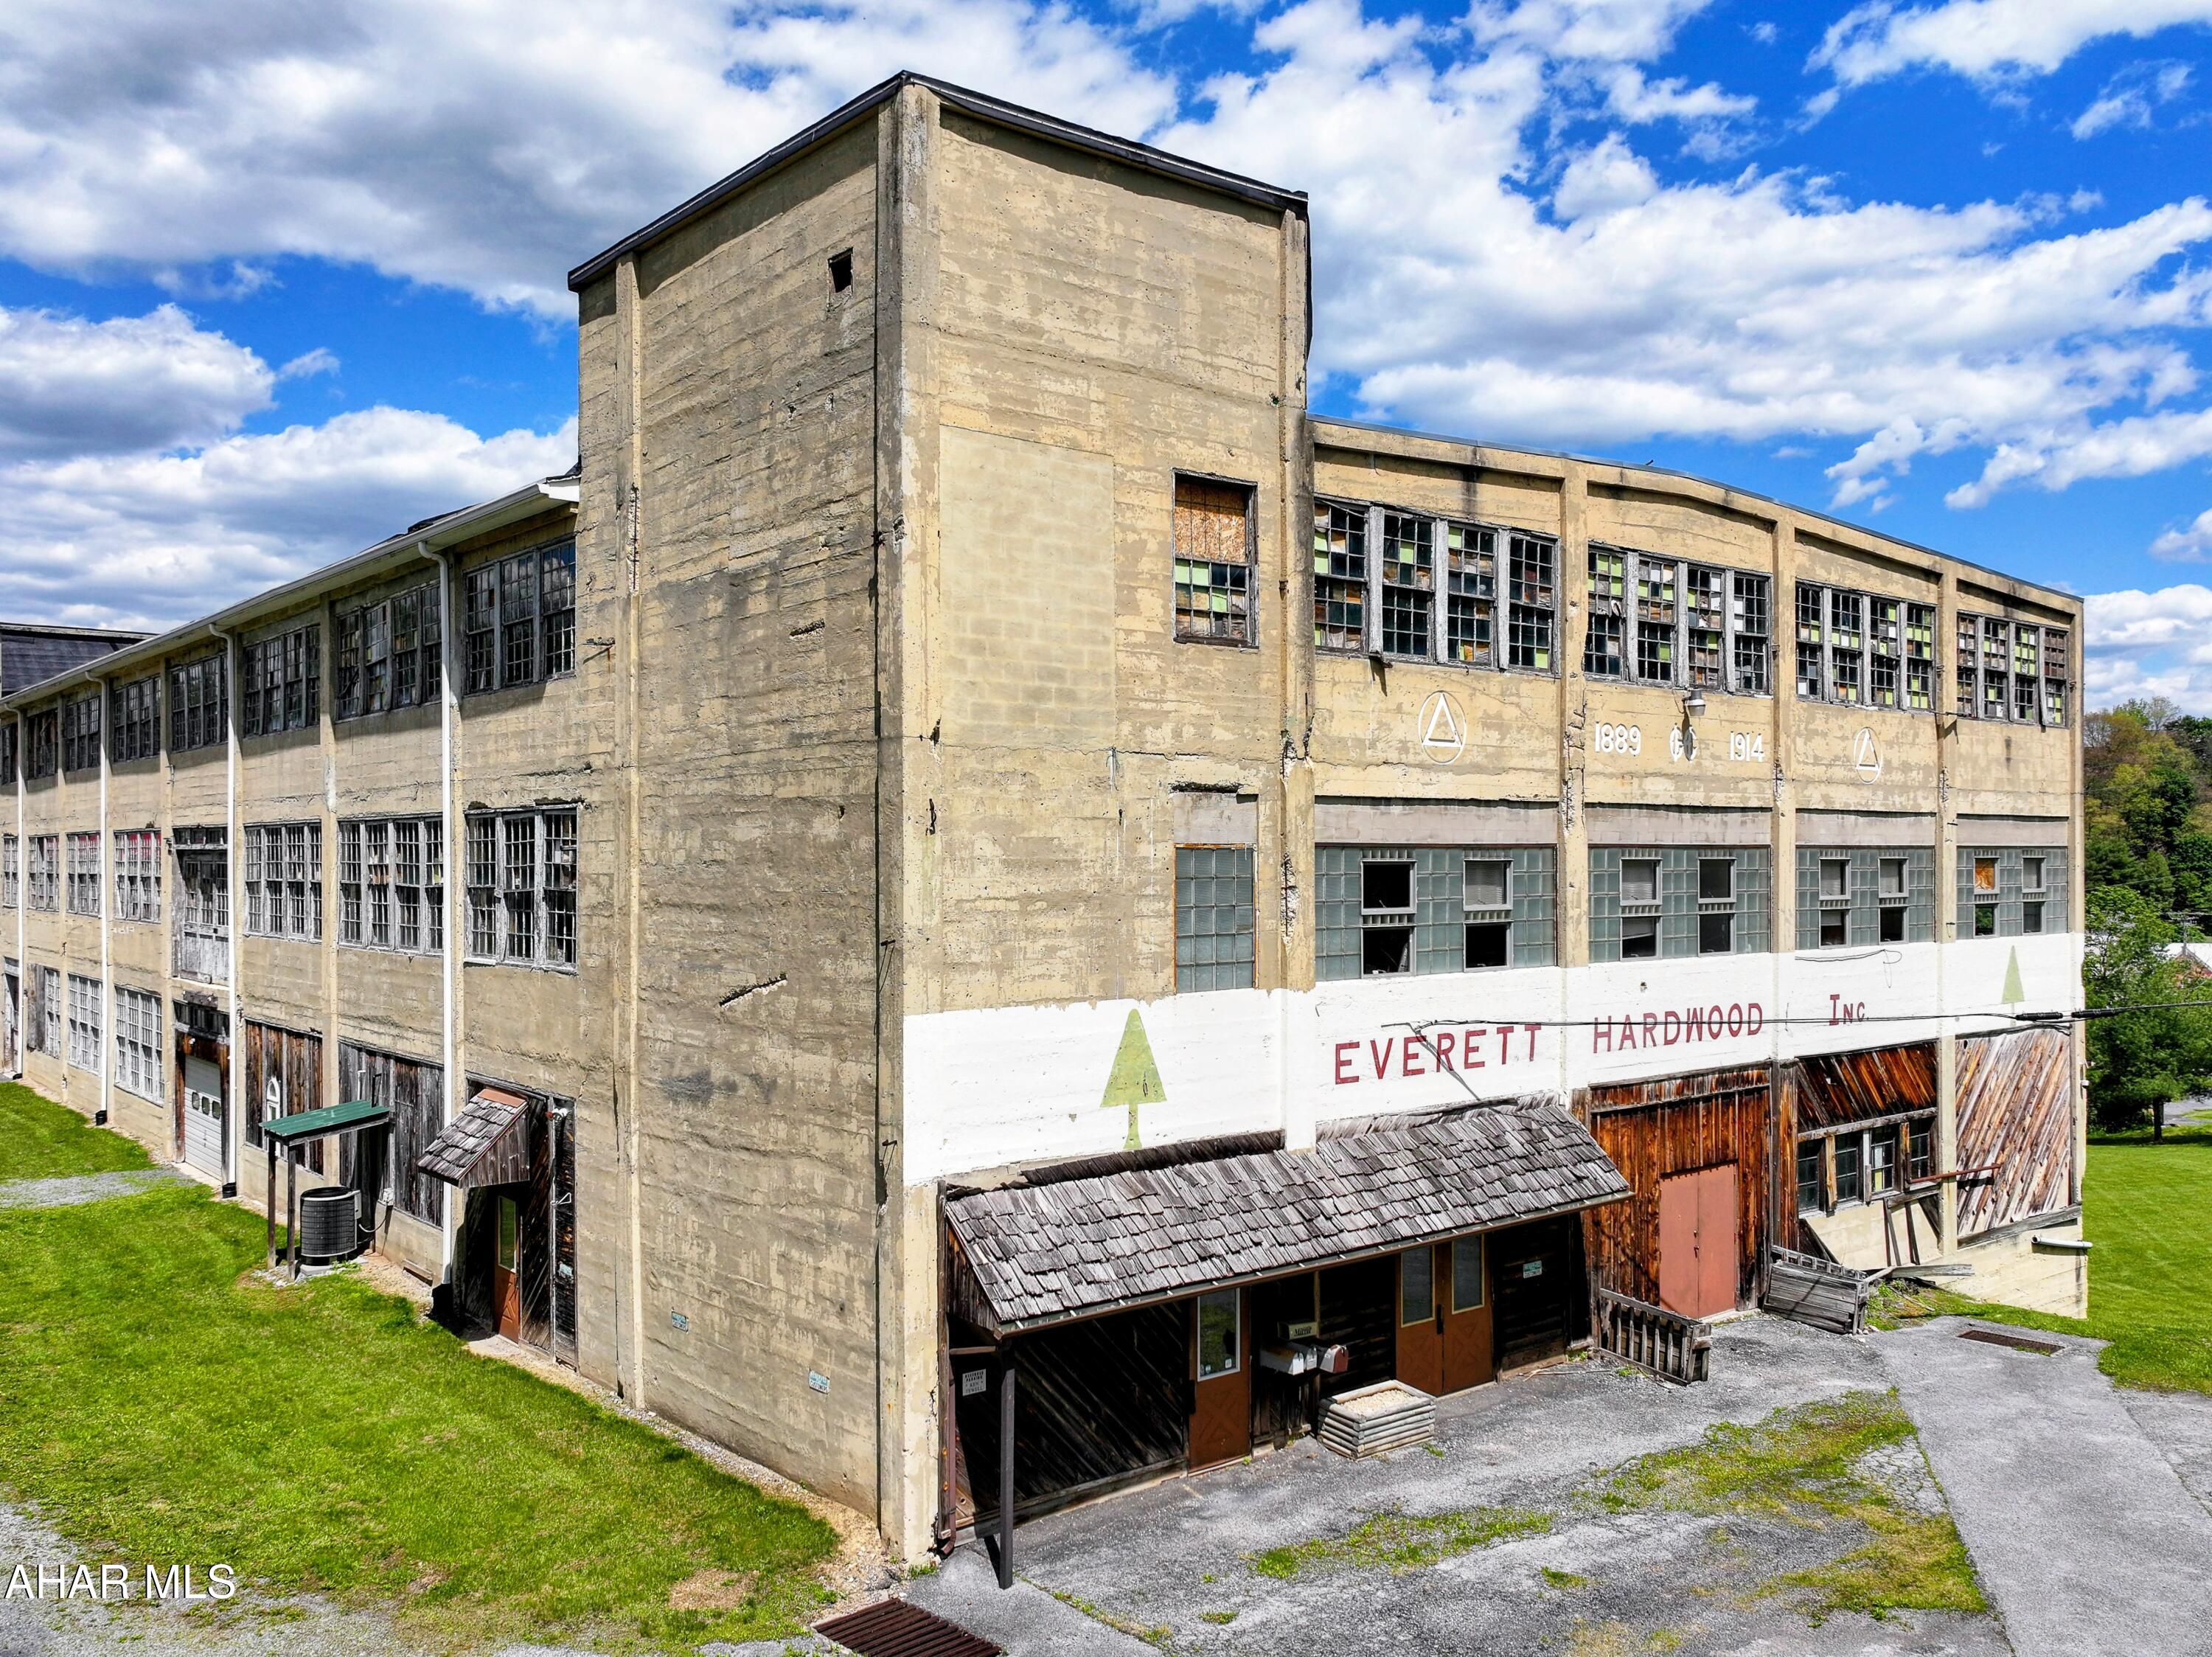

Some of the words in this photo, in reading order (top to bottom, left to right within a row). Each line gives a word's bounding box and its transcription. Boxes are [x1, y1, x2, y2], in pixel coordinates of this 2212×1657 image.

[1595, 722, 1641, 756] 1889
[1730, 731, 1765, 763] 1914
[1335, 1024, 1543, 1085] EVERETT
[1593, 1003, 1763, 1053] HARDWOOD
